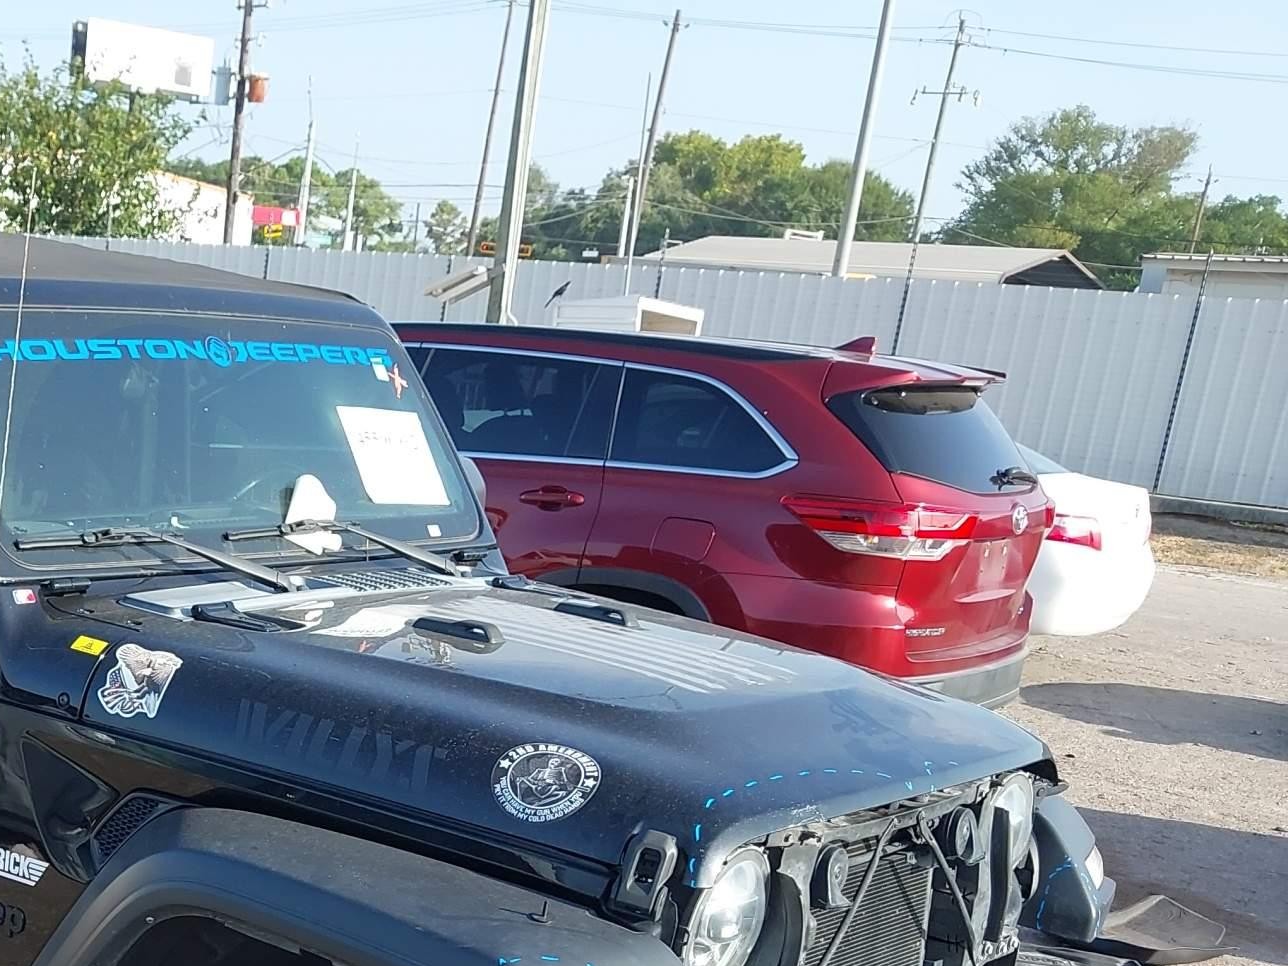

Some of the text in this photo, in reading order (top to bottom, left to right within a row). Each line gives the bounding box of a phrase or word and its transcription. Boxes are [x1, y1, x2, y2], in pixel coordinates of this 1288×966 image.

[230, 340, 392, 367] JEEPERS
[539, 744, 599, 777] AMENDMENT
[509, 799, 524, 812] HAVE
[524, 808, 536, 816] MY
[551, 801, 570, 813] WHEN
